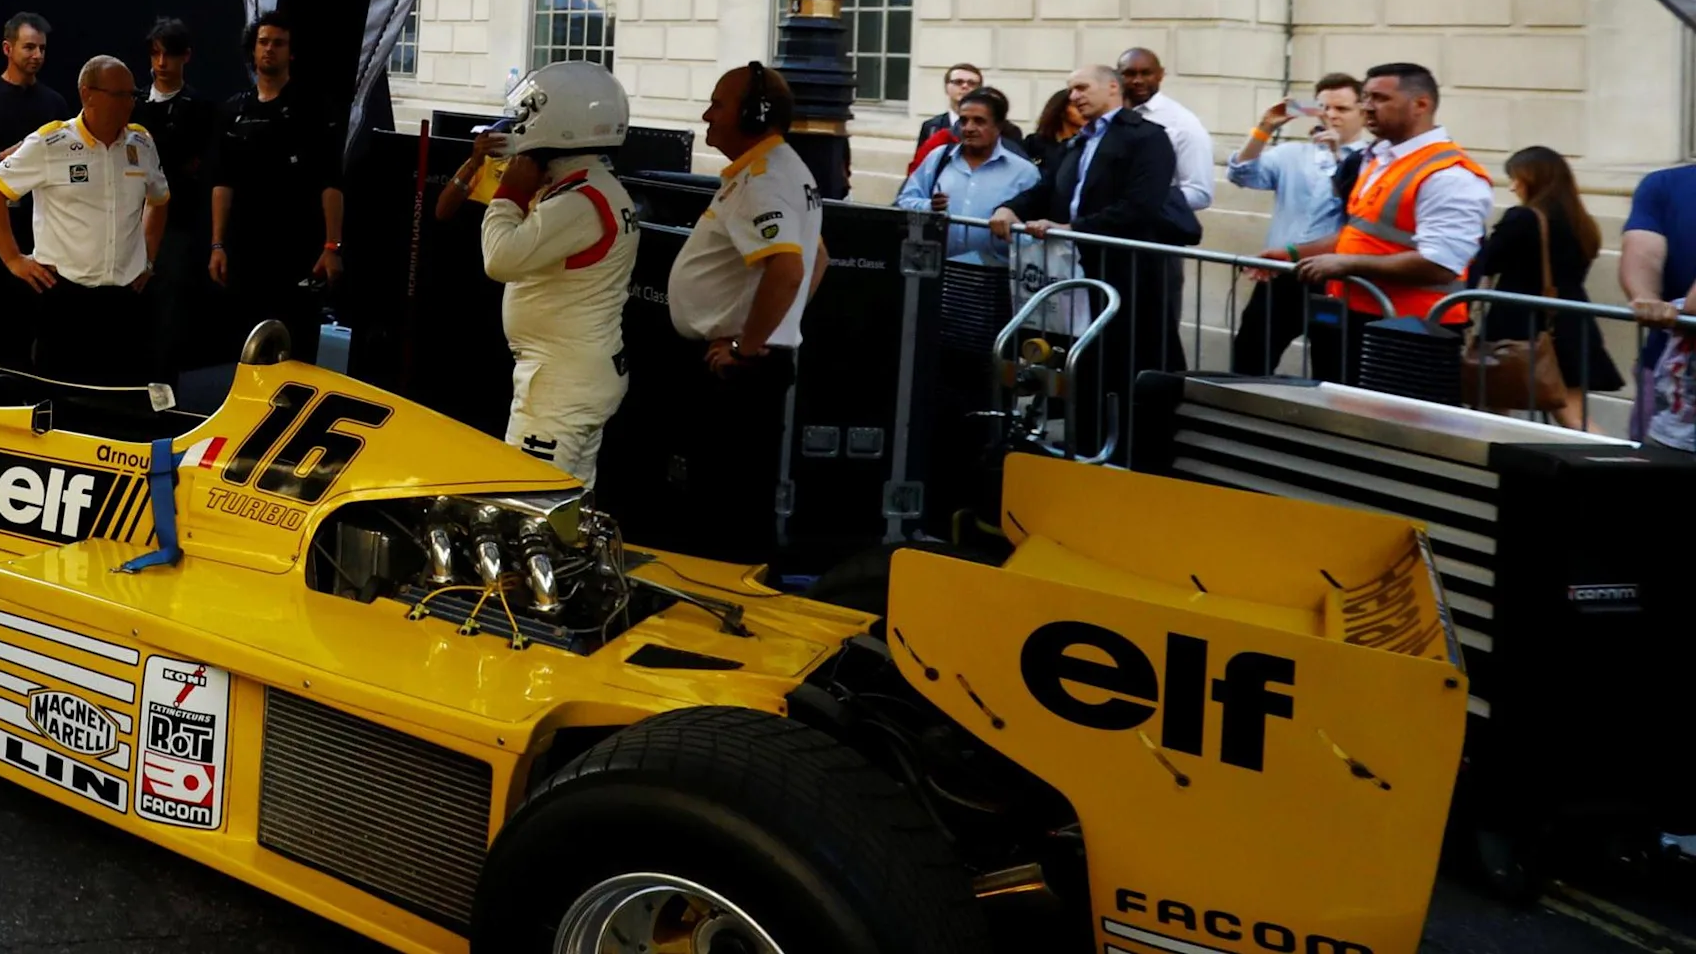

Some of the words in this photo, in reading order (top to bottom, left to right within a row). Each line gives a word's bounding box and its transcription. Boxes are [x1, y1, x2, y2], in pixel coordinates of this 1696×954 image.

[644, 286, 668, 305] Class
[97, 444, 150, 469] arnou
[221, 381, 394, 505] 16
[207, 487, 307, 531] TURBO
[164, 669, 205, 686] KONI
[151, 703, 211, 723] EXTINCTEURS
[1018, 619, 1296, 772] elf
[35, 694, 110, 738] MAGNETI
[35, 710, 110, 751] MARELLI
[142, 794, 210, 824] FACOM
